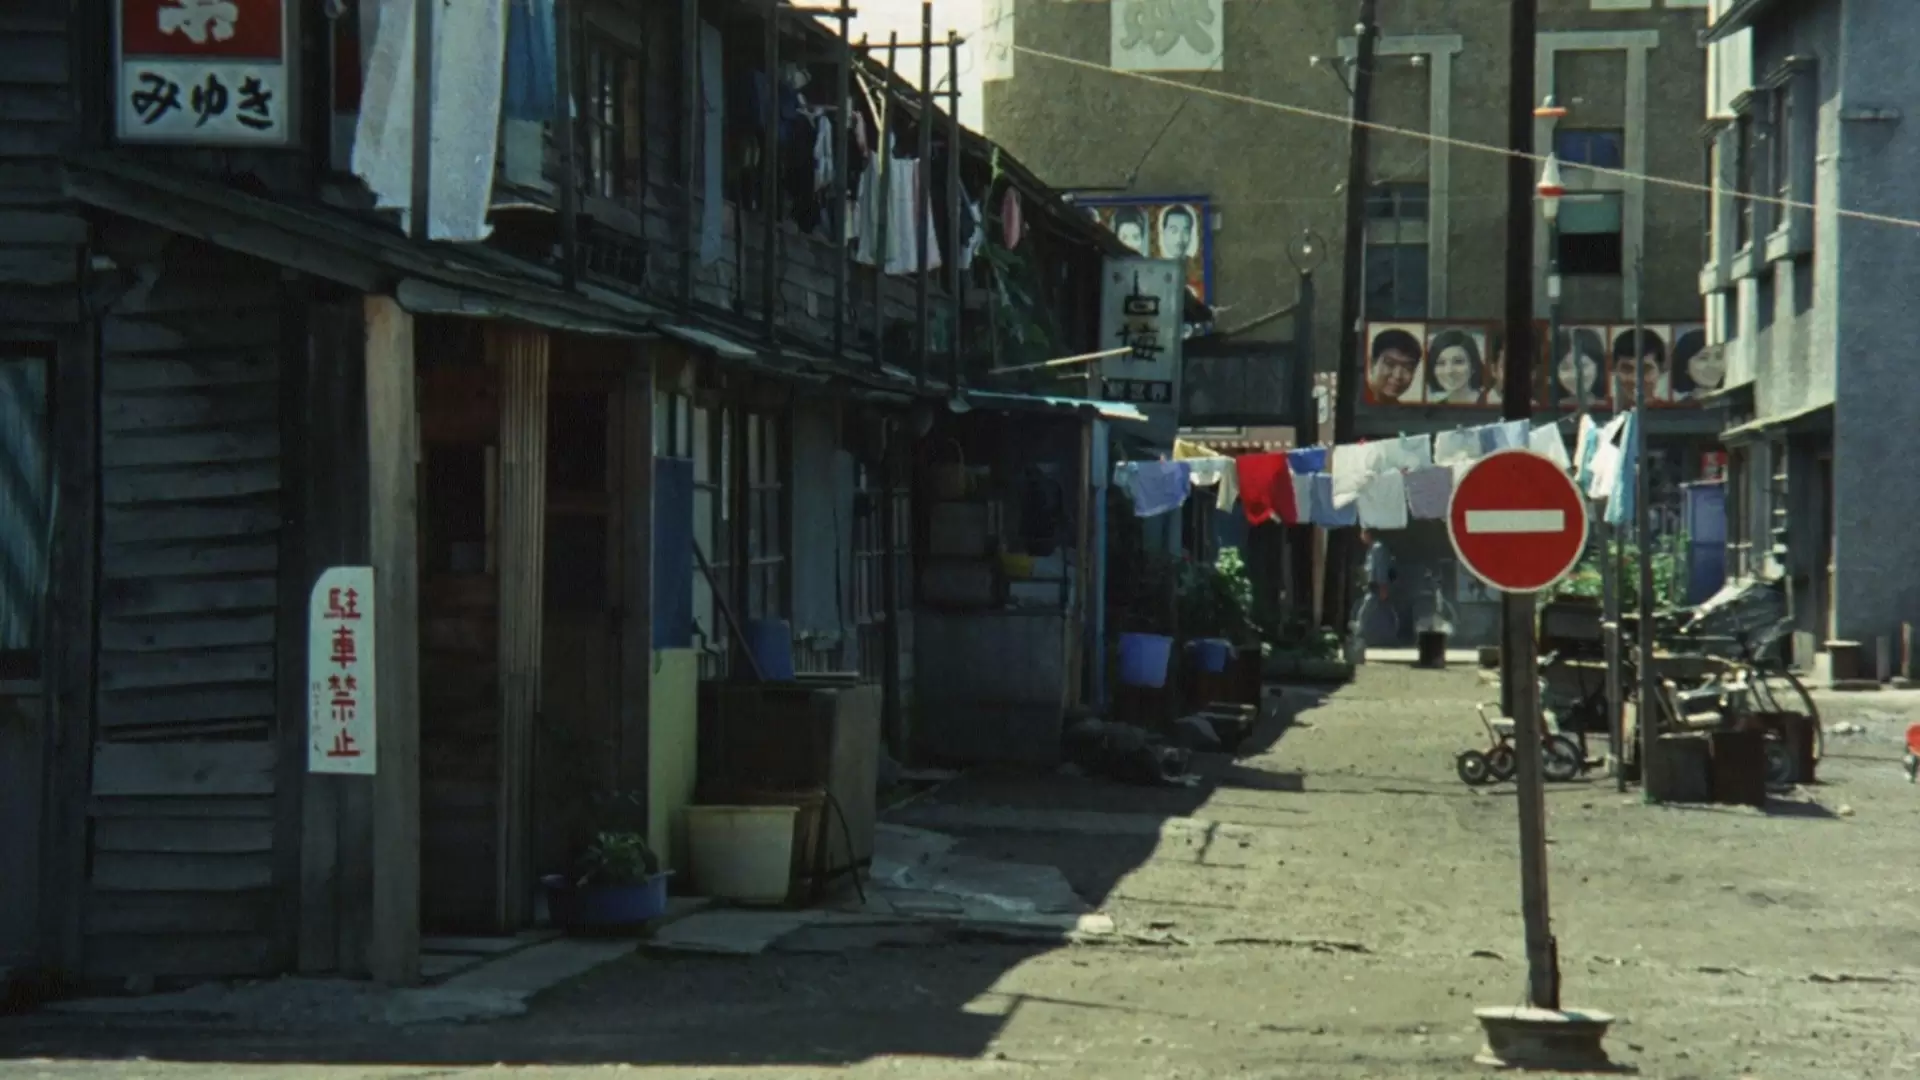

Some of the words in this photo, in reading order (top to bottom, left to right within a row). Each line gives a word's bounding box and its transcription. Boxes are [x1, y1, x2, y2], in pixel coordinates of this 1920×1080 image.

[131, 71, 274, 130] みゆき
[323, 587, 362, 757] 駐車禁止
